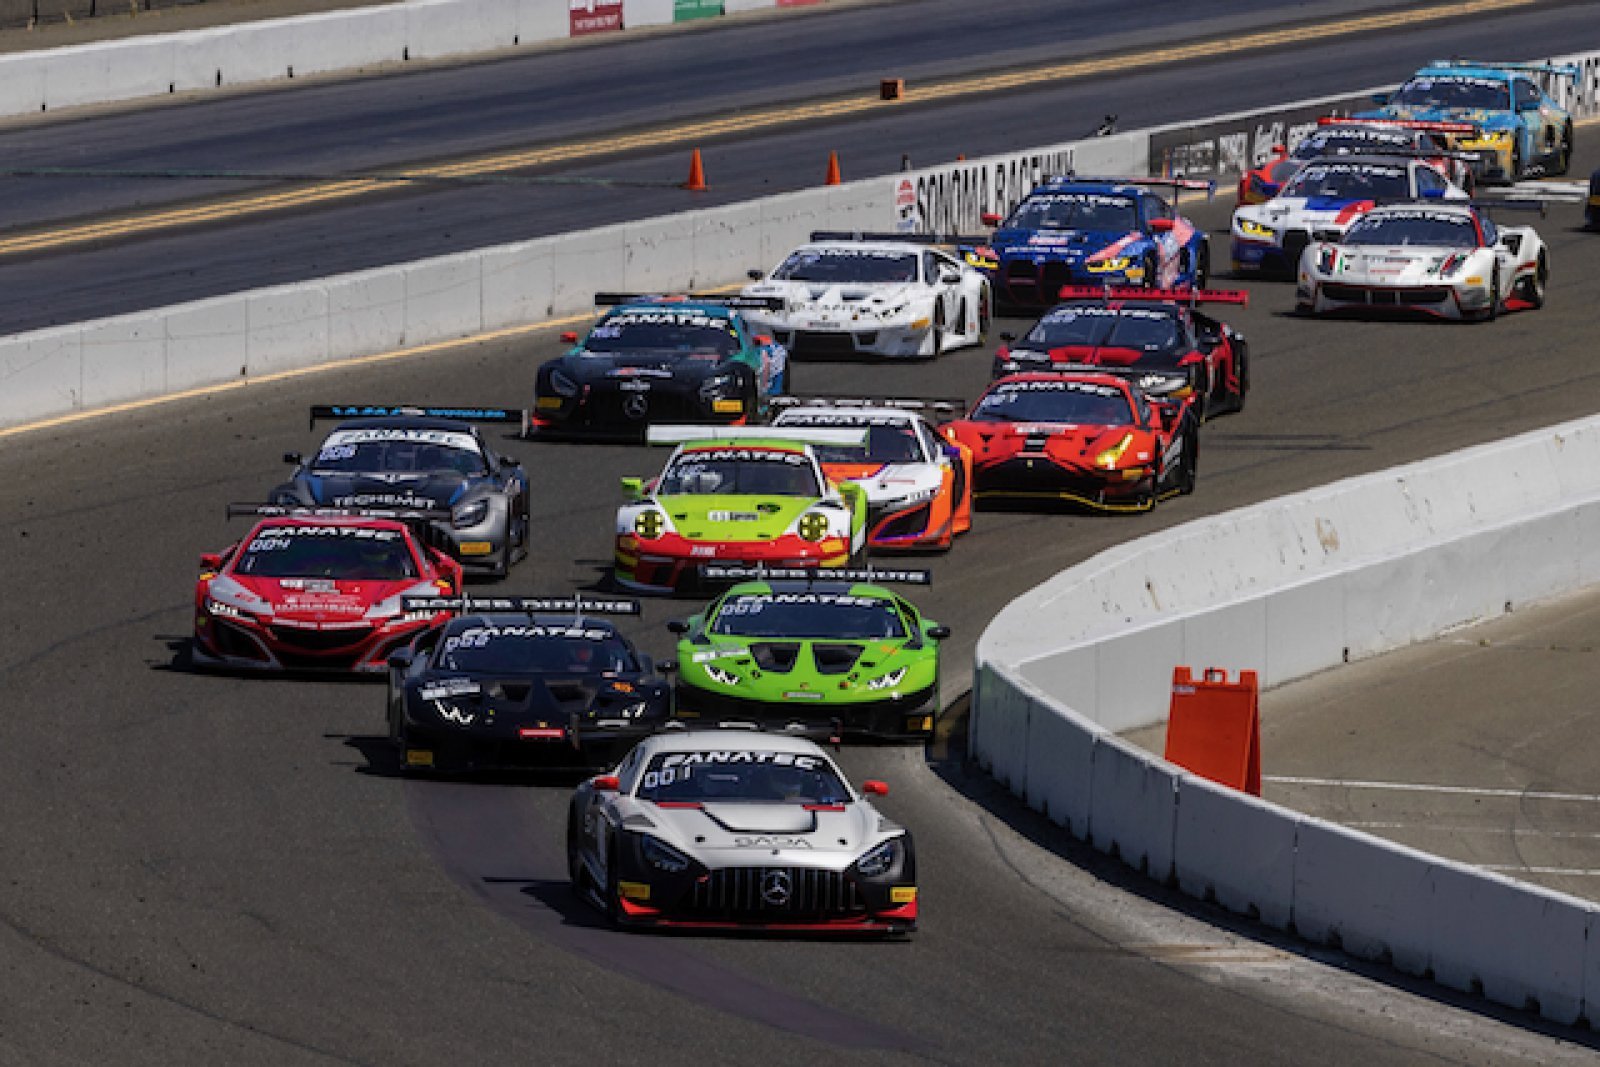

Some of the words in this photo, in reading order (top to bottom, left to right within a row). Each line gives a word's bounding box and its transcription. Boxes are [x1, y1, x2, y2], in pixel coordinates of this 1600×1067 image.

[604, 314, 729, 328] FANATEC
[997, 382, 1121, 396] FANATEC
[338, 429, 468, 445] FANATEC
[675, 450, 807, 464] FANATEC
[258, 526, 400, 541] FANATEC
[736, 594, 883, 606] FANATEC
[461, 626, 612, 639] FANATEC
[662, 751, 825, 770] FANATEC
[644, 765, 691, 788] 001
